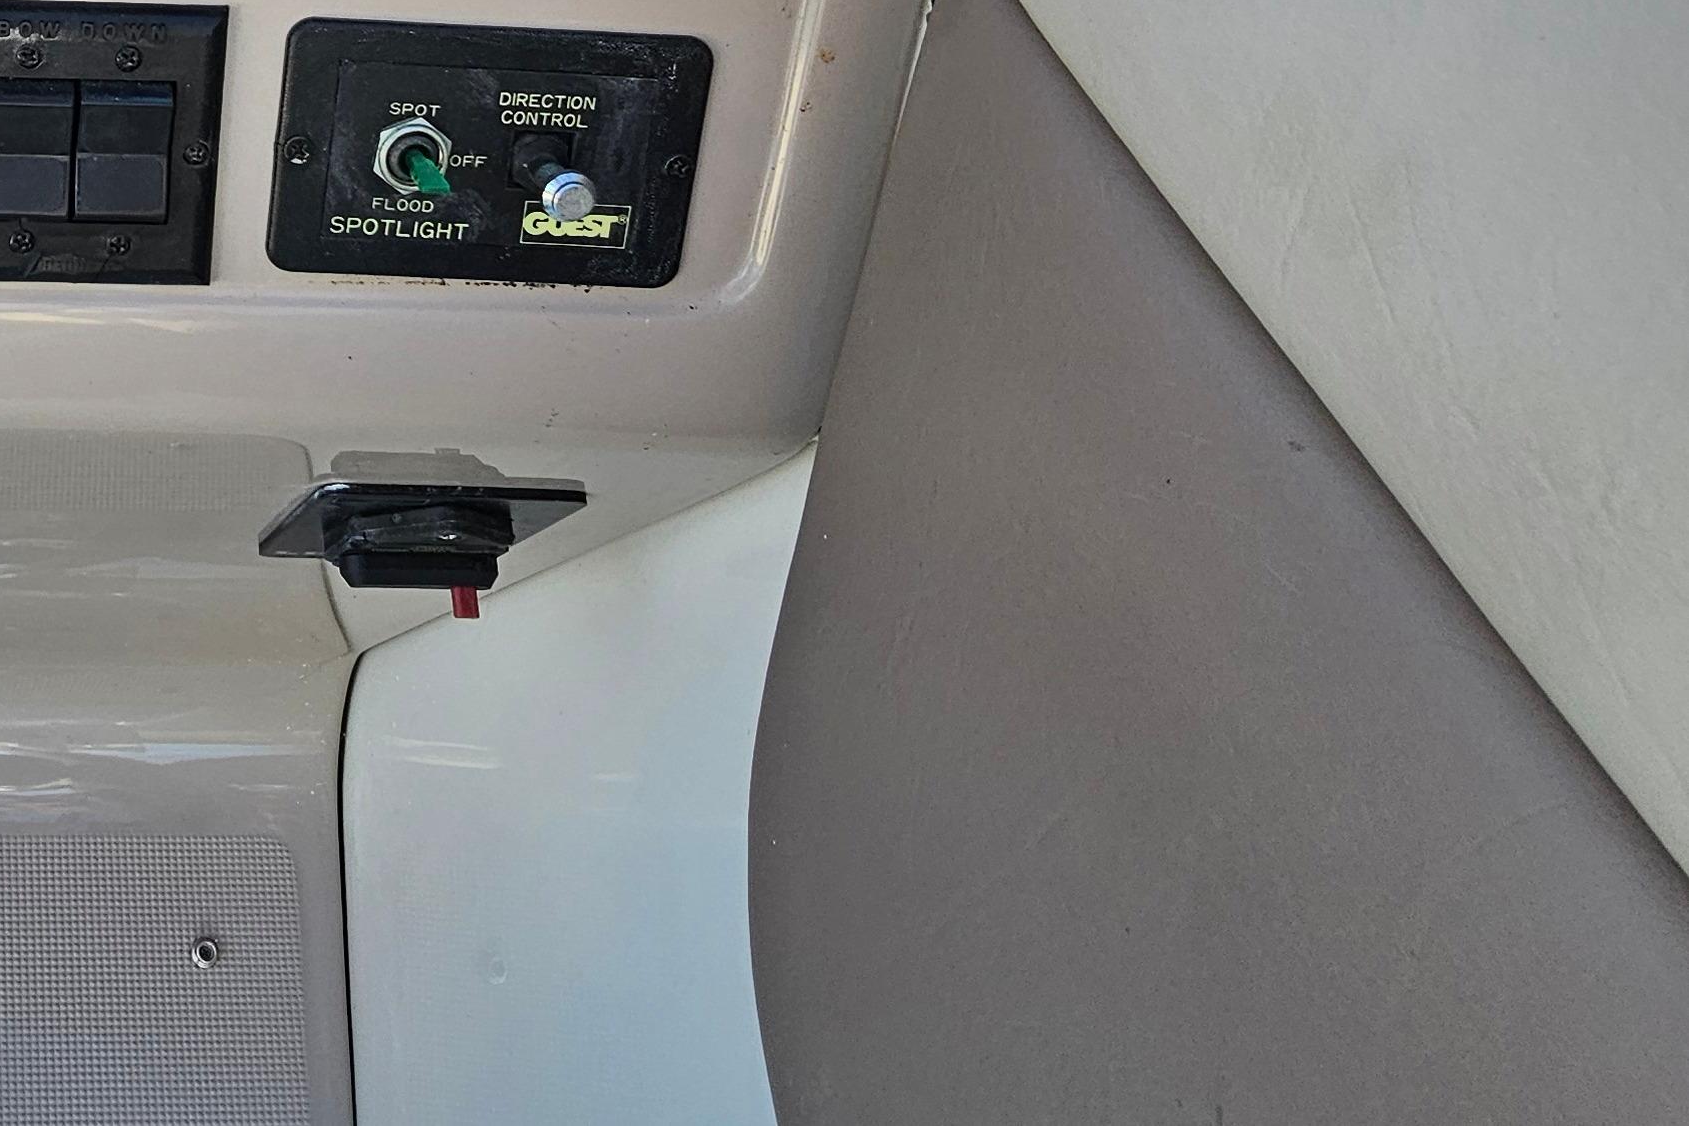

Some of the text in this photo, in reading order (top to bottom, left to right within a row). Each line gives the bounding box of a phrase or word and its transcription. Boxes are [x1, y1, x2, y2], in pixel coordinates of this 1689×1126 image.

[81, 21, 167, 42] DOWN
[389, 102, 441, 117] SPOT
[499, 92, 597, 110] DIRECTION
[501, 110, 588, 128] CONTROL
[449, 155, 488, 168] OFF
[371, 197, 434, 213] FLOOD
[329, 216, 469, 240] SPOTLIGHT
